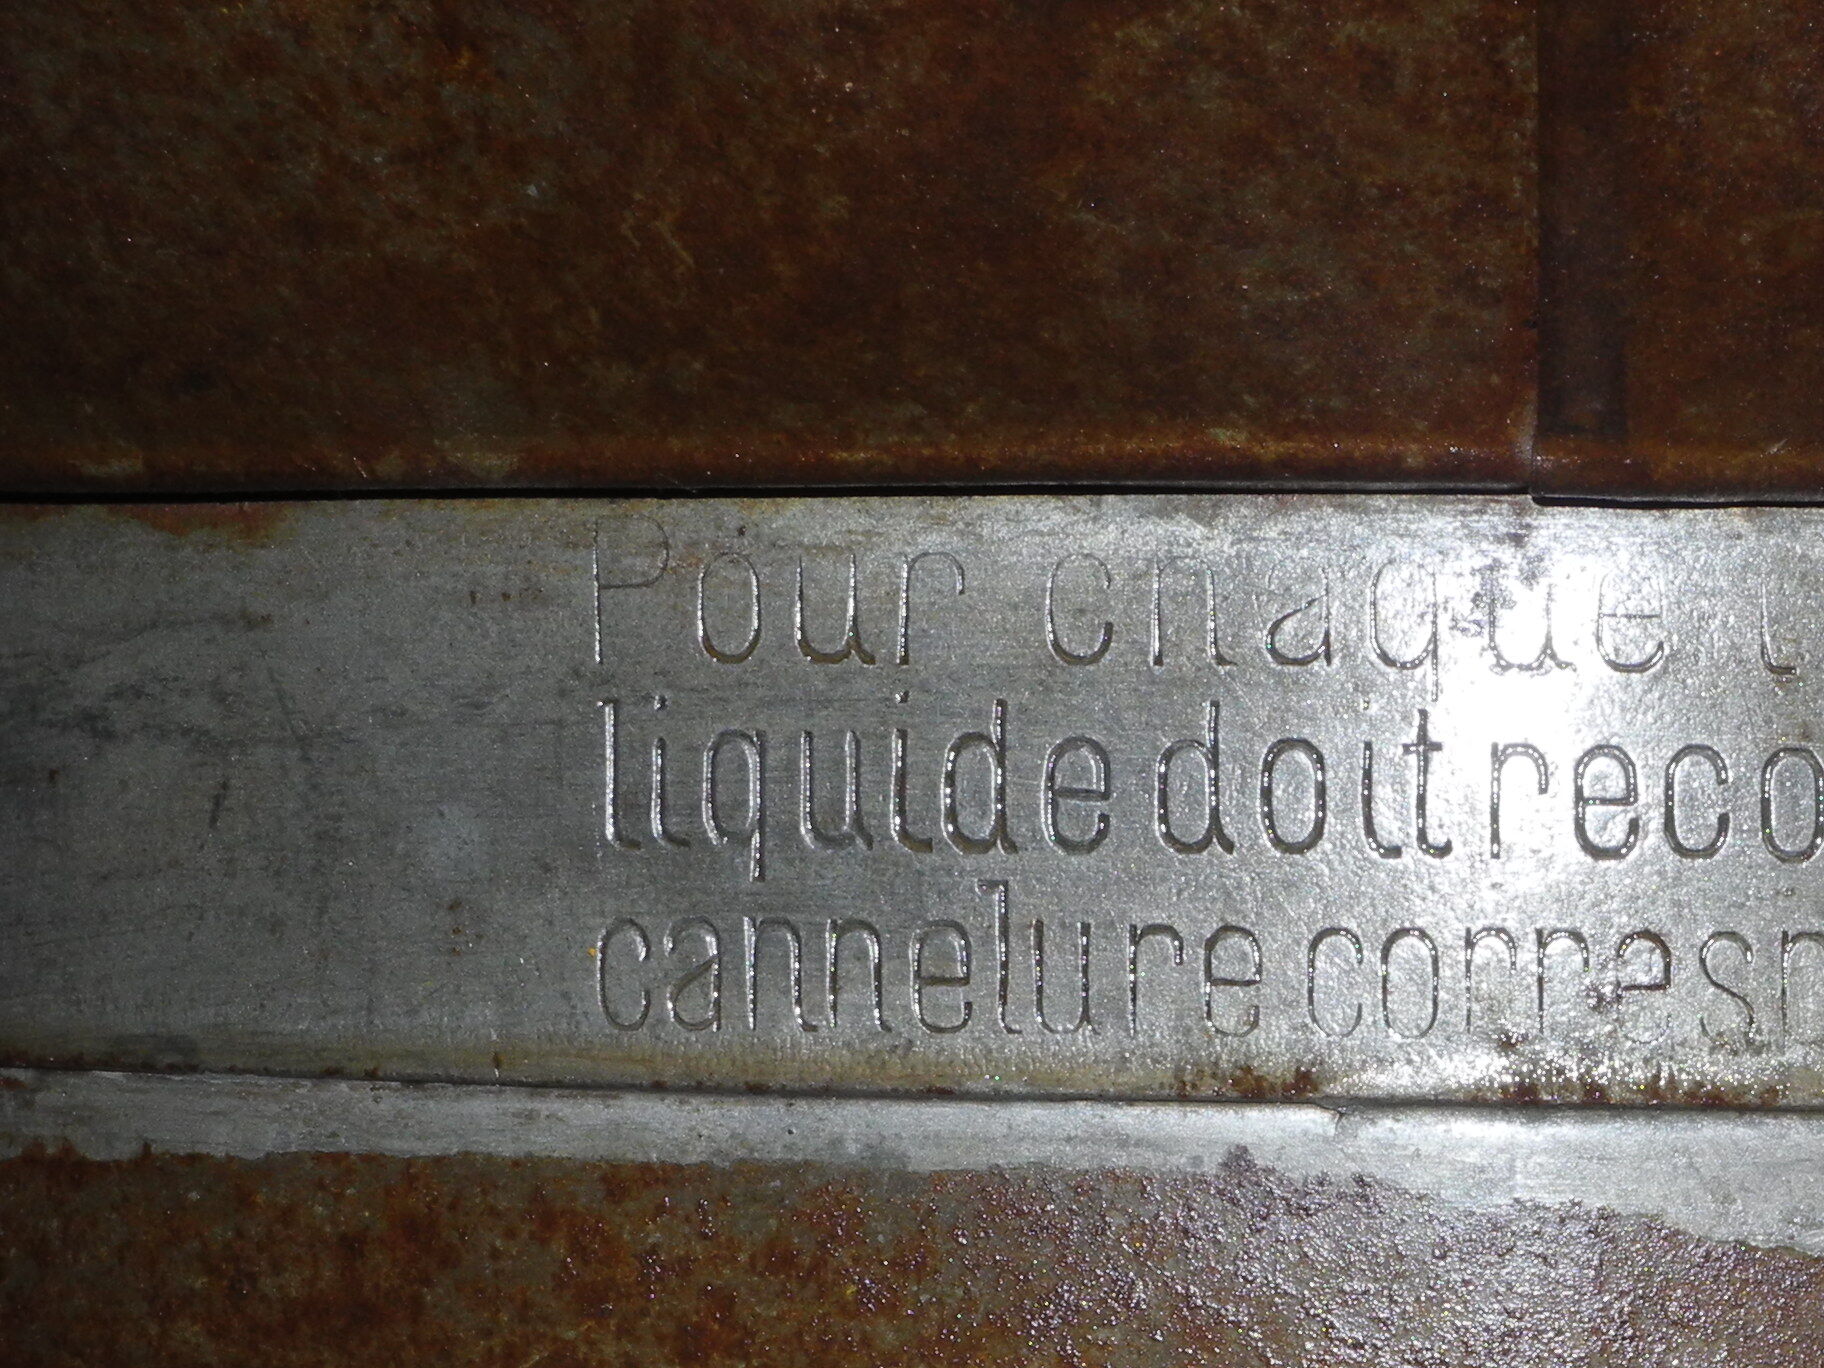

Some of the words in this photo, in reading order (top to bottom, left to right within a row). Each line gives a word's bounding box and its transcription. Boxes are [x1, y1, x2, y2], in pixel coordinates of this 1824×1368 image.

[590, 512, 966, 667] Pour
[597, 690, 1112, 882] liquide
[1154, 696, 1455, 860] doit
[595, 878, 1264, 1040] cannelure
